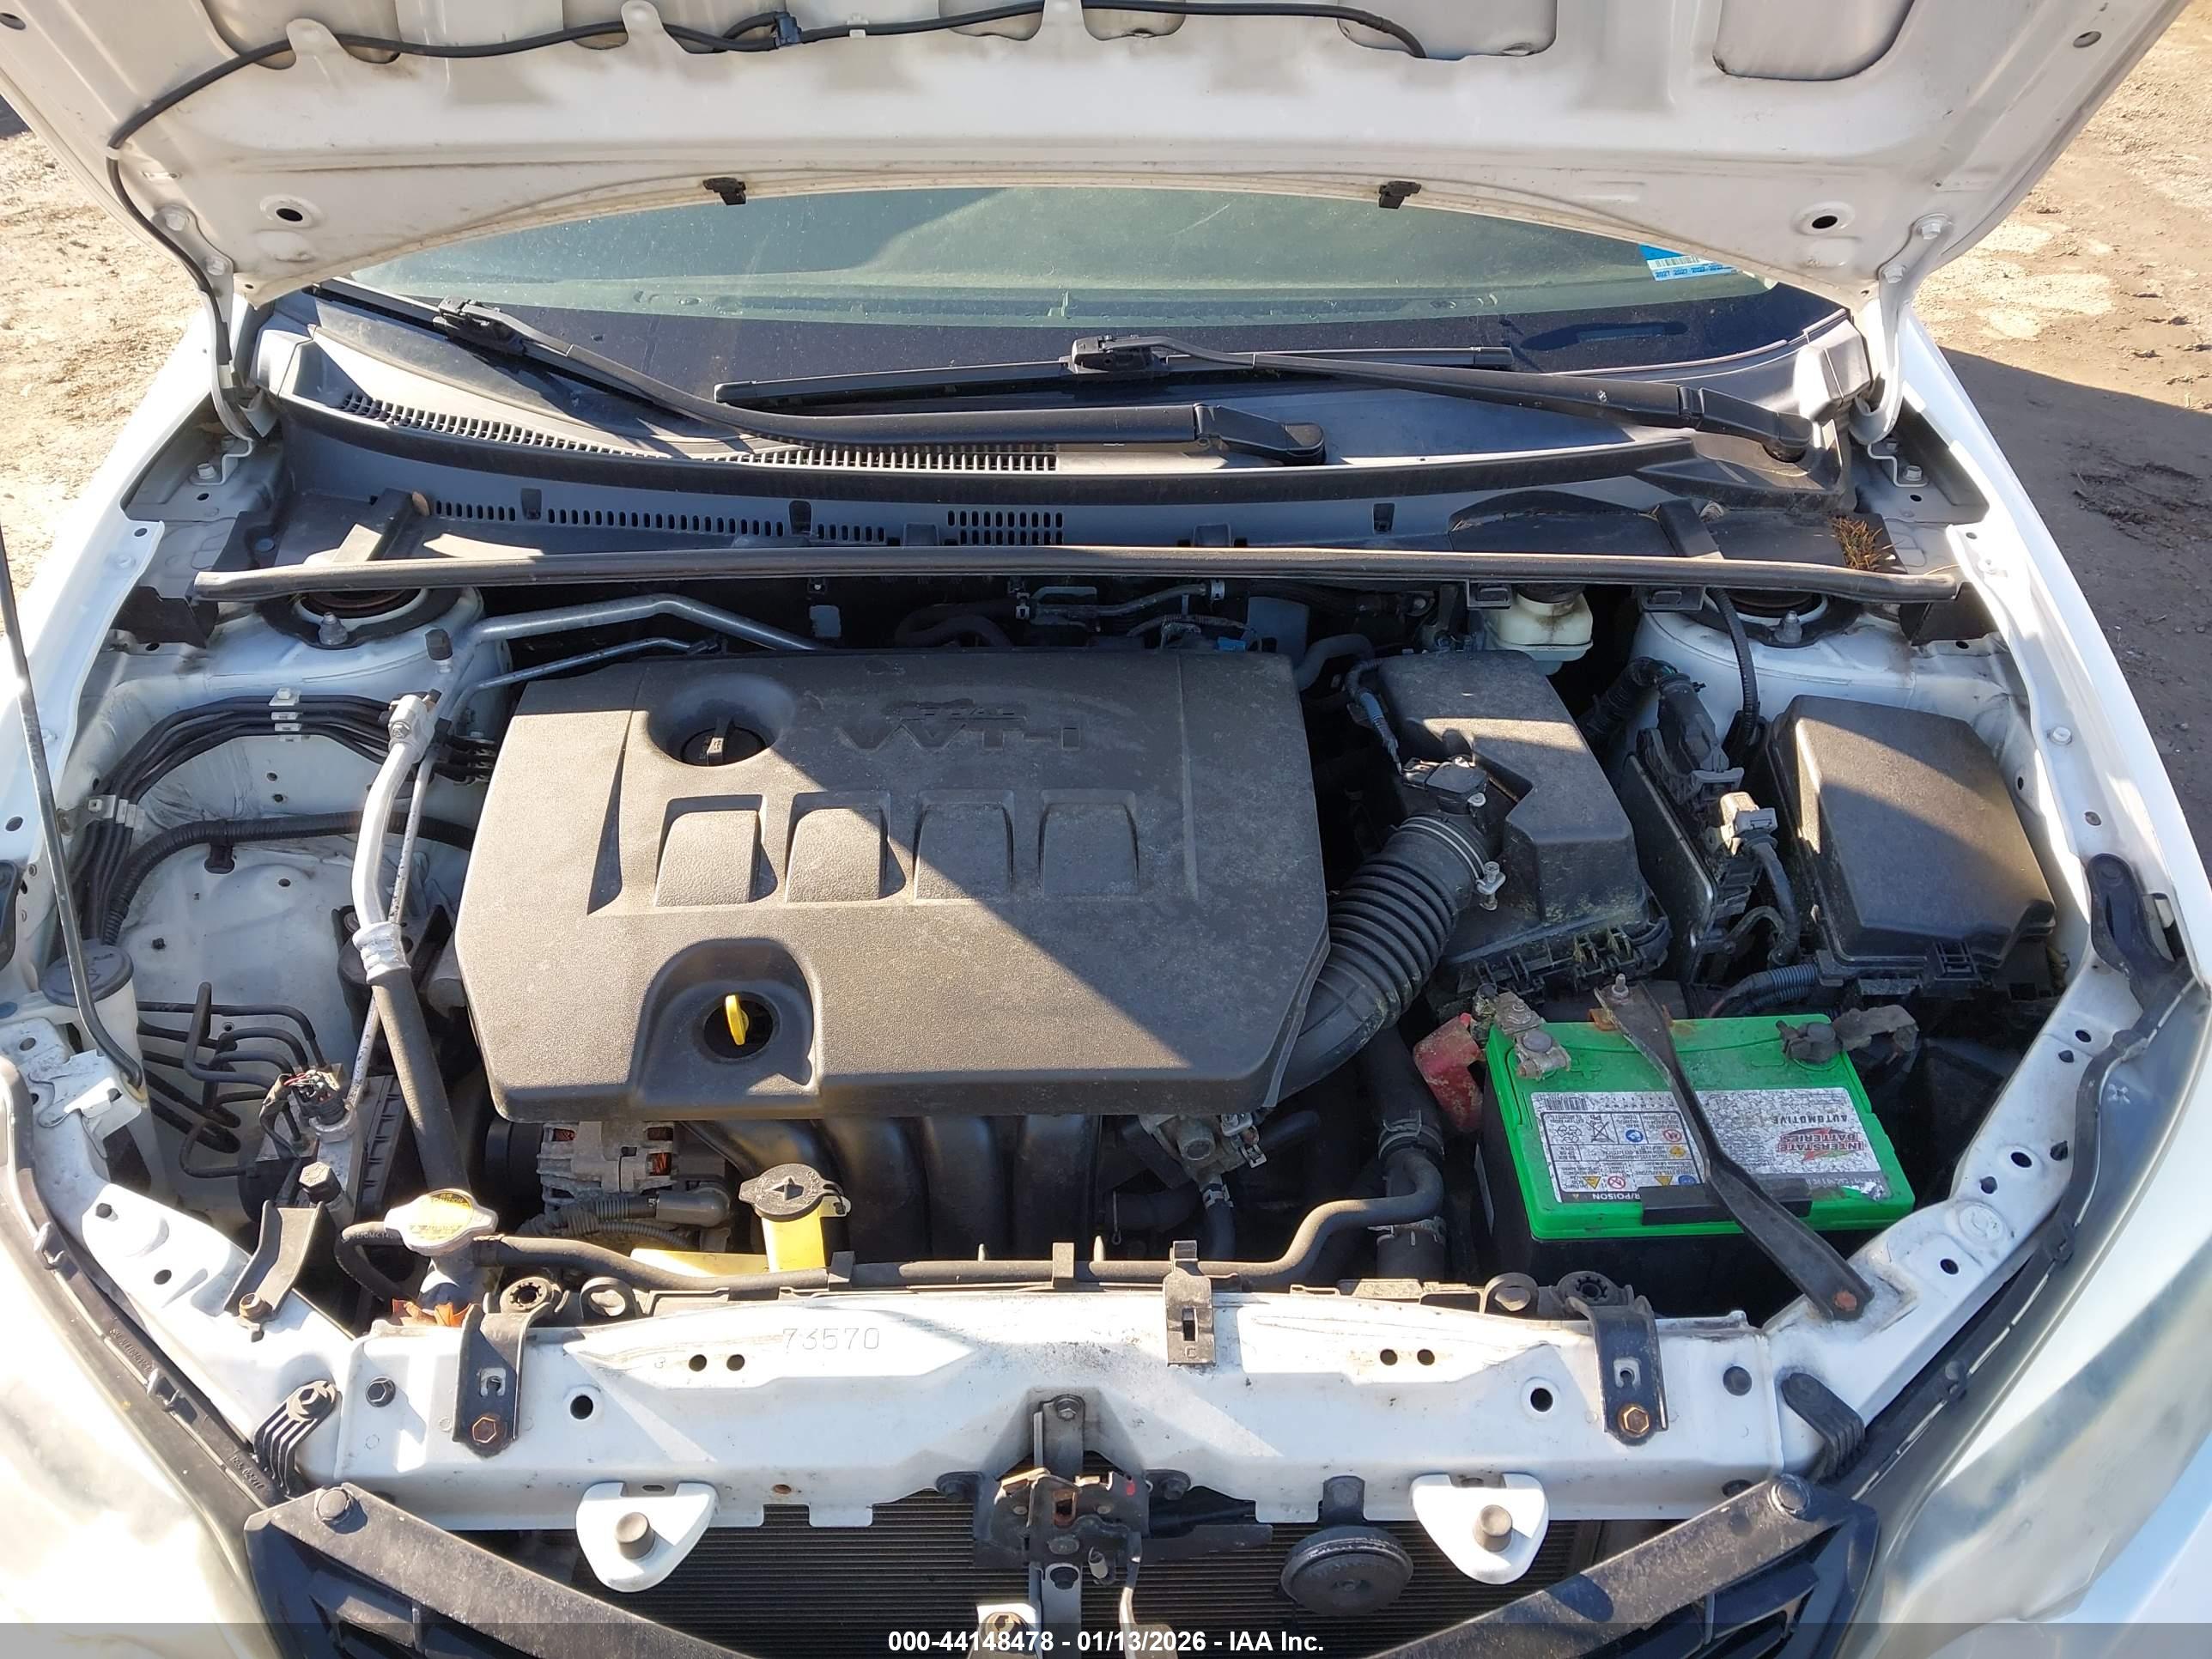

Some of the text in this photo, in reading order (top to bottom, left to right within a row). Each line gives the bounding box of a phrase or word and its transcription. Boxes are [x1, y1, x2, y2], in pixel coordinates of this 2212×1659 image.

[1771, 1115, 1848, 1125] AUTOMOTIVE
[1779, 1133, 1856, 1142] BATTERIES
[1778, 1142, 1863, 1152] INTERSTATE
[1591, 1192, 1642, 1200] R/POISON
[782, 1327, 880, 1351] 73570
